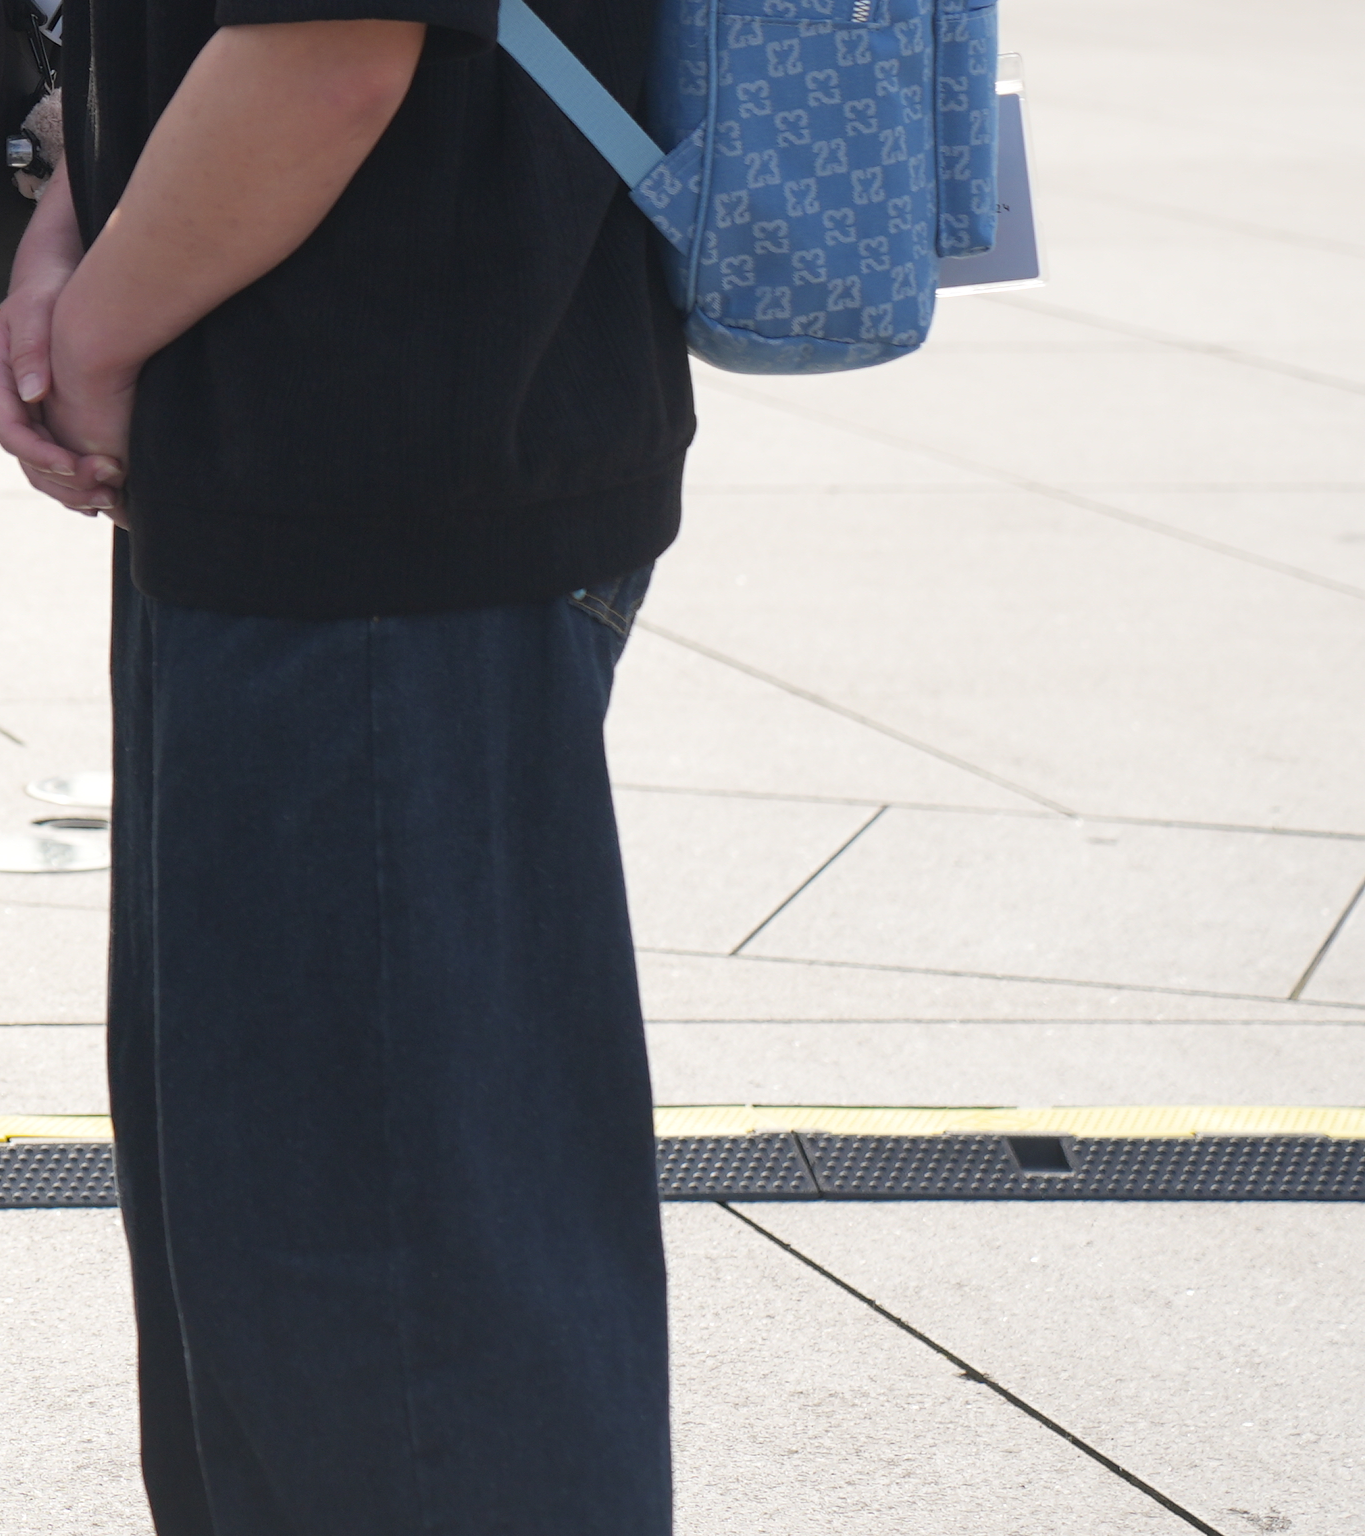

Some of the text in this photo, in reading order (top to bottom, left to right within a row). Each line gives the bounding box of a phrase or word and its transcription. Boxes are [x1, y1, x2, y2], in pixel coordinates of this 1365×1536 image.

[767, 38, 803, 78] 23
[835, 29, 871, 67] 23
[805, 69, 841, 107] 23
[874, 59, 900, 96] 23
[737, 79, 770, 119] 23
[843, 97, 878, 137] 23
[774, 109, 811, 148] 23
[879, 125, 906, 165] 23
[744, 149, 781, 189] 23
[812, 138, 848, 177] 23
[783, 177, 820, 218] 23
[851, 166, 885, 205] 23
[714, 189, 751, 229] 23
[823, 207, 857, 247] 23
[888, 195, 912, 234] 23
[752, 219, 790, 255] 23
[858, 236, 891, 274] 23
[720, 255, 756, 291] 23
[792, 248, 827, 286] 23
[891, 262, 917, 301] 23
[755, 286, 792, 321] 23
[827, 275, 861, 312] 23
[860, 303, 893, 339] 23
